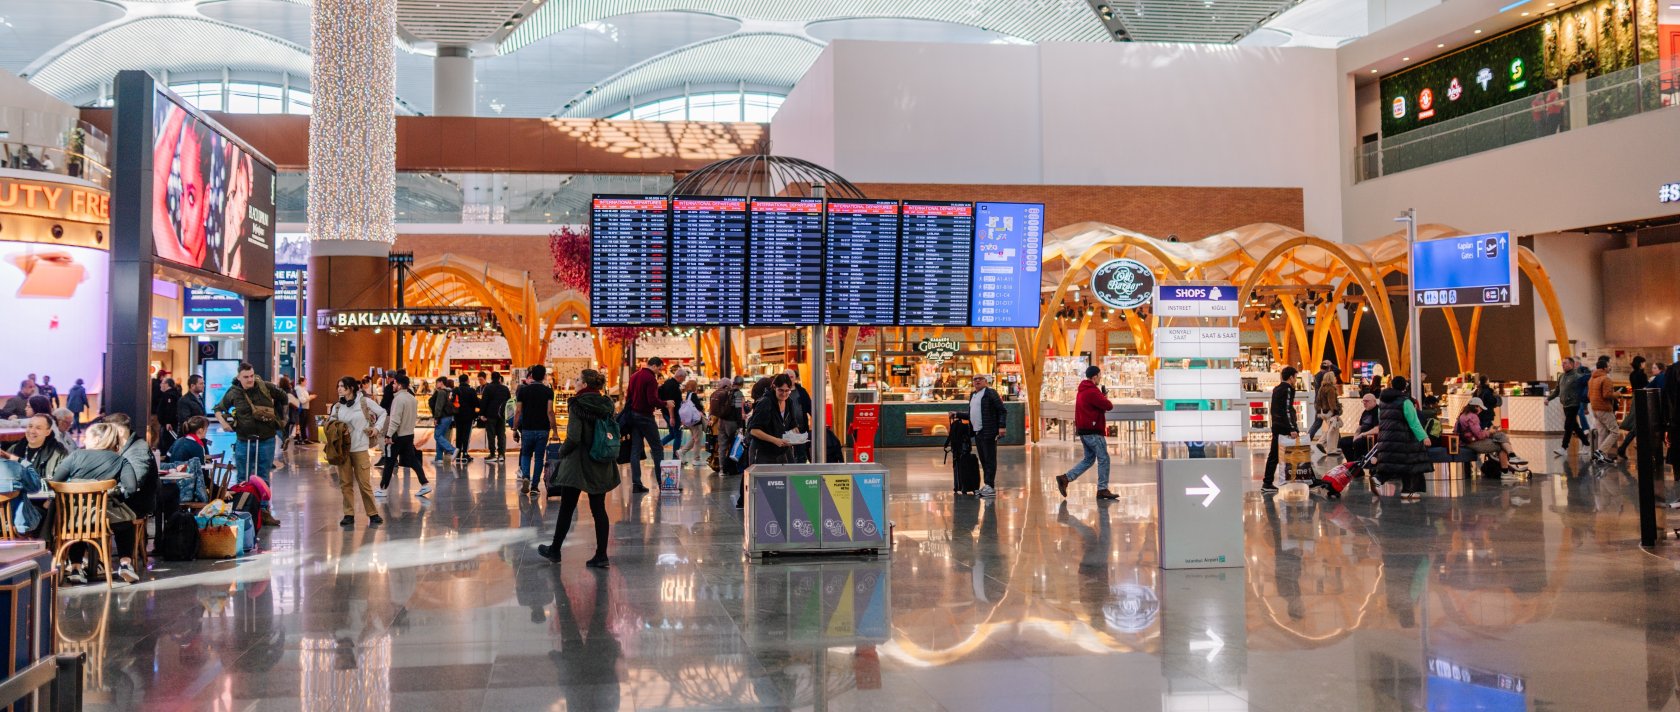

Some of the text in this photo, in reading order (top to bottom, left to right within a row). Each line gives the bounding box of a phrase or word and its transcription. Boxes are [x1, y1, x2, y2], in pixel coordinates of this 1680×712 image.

[1477, 240, 1483, 258] F
[1175, 288, 1206, 298] SHOPS
[338, 312, 411, 326] BAKLAVA
